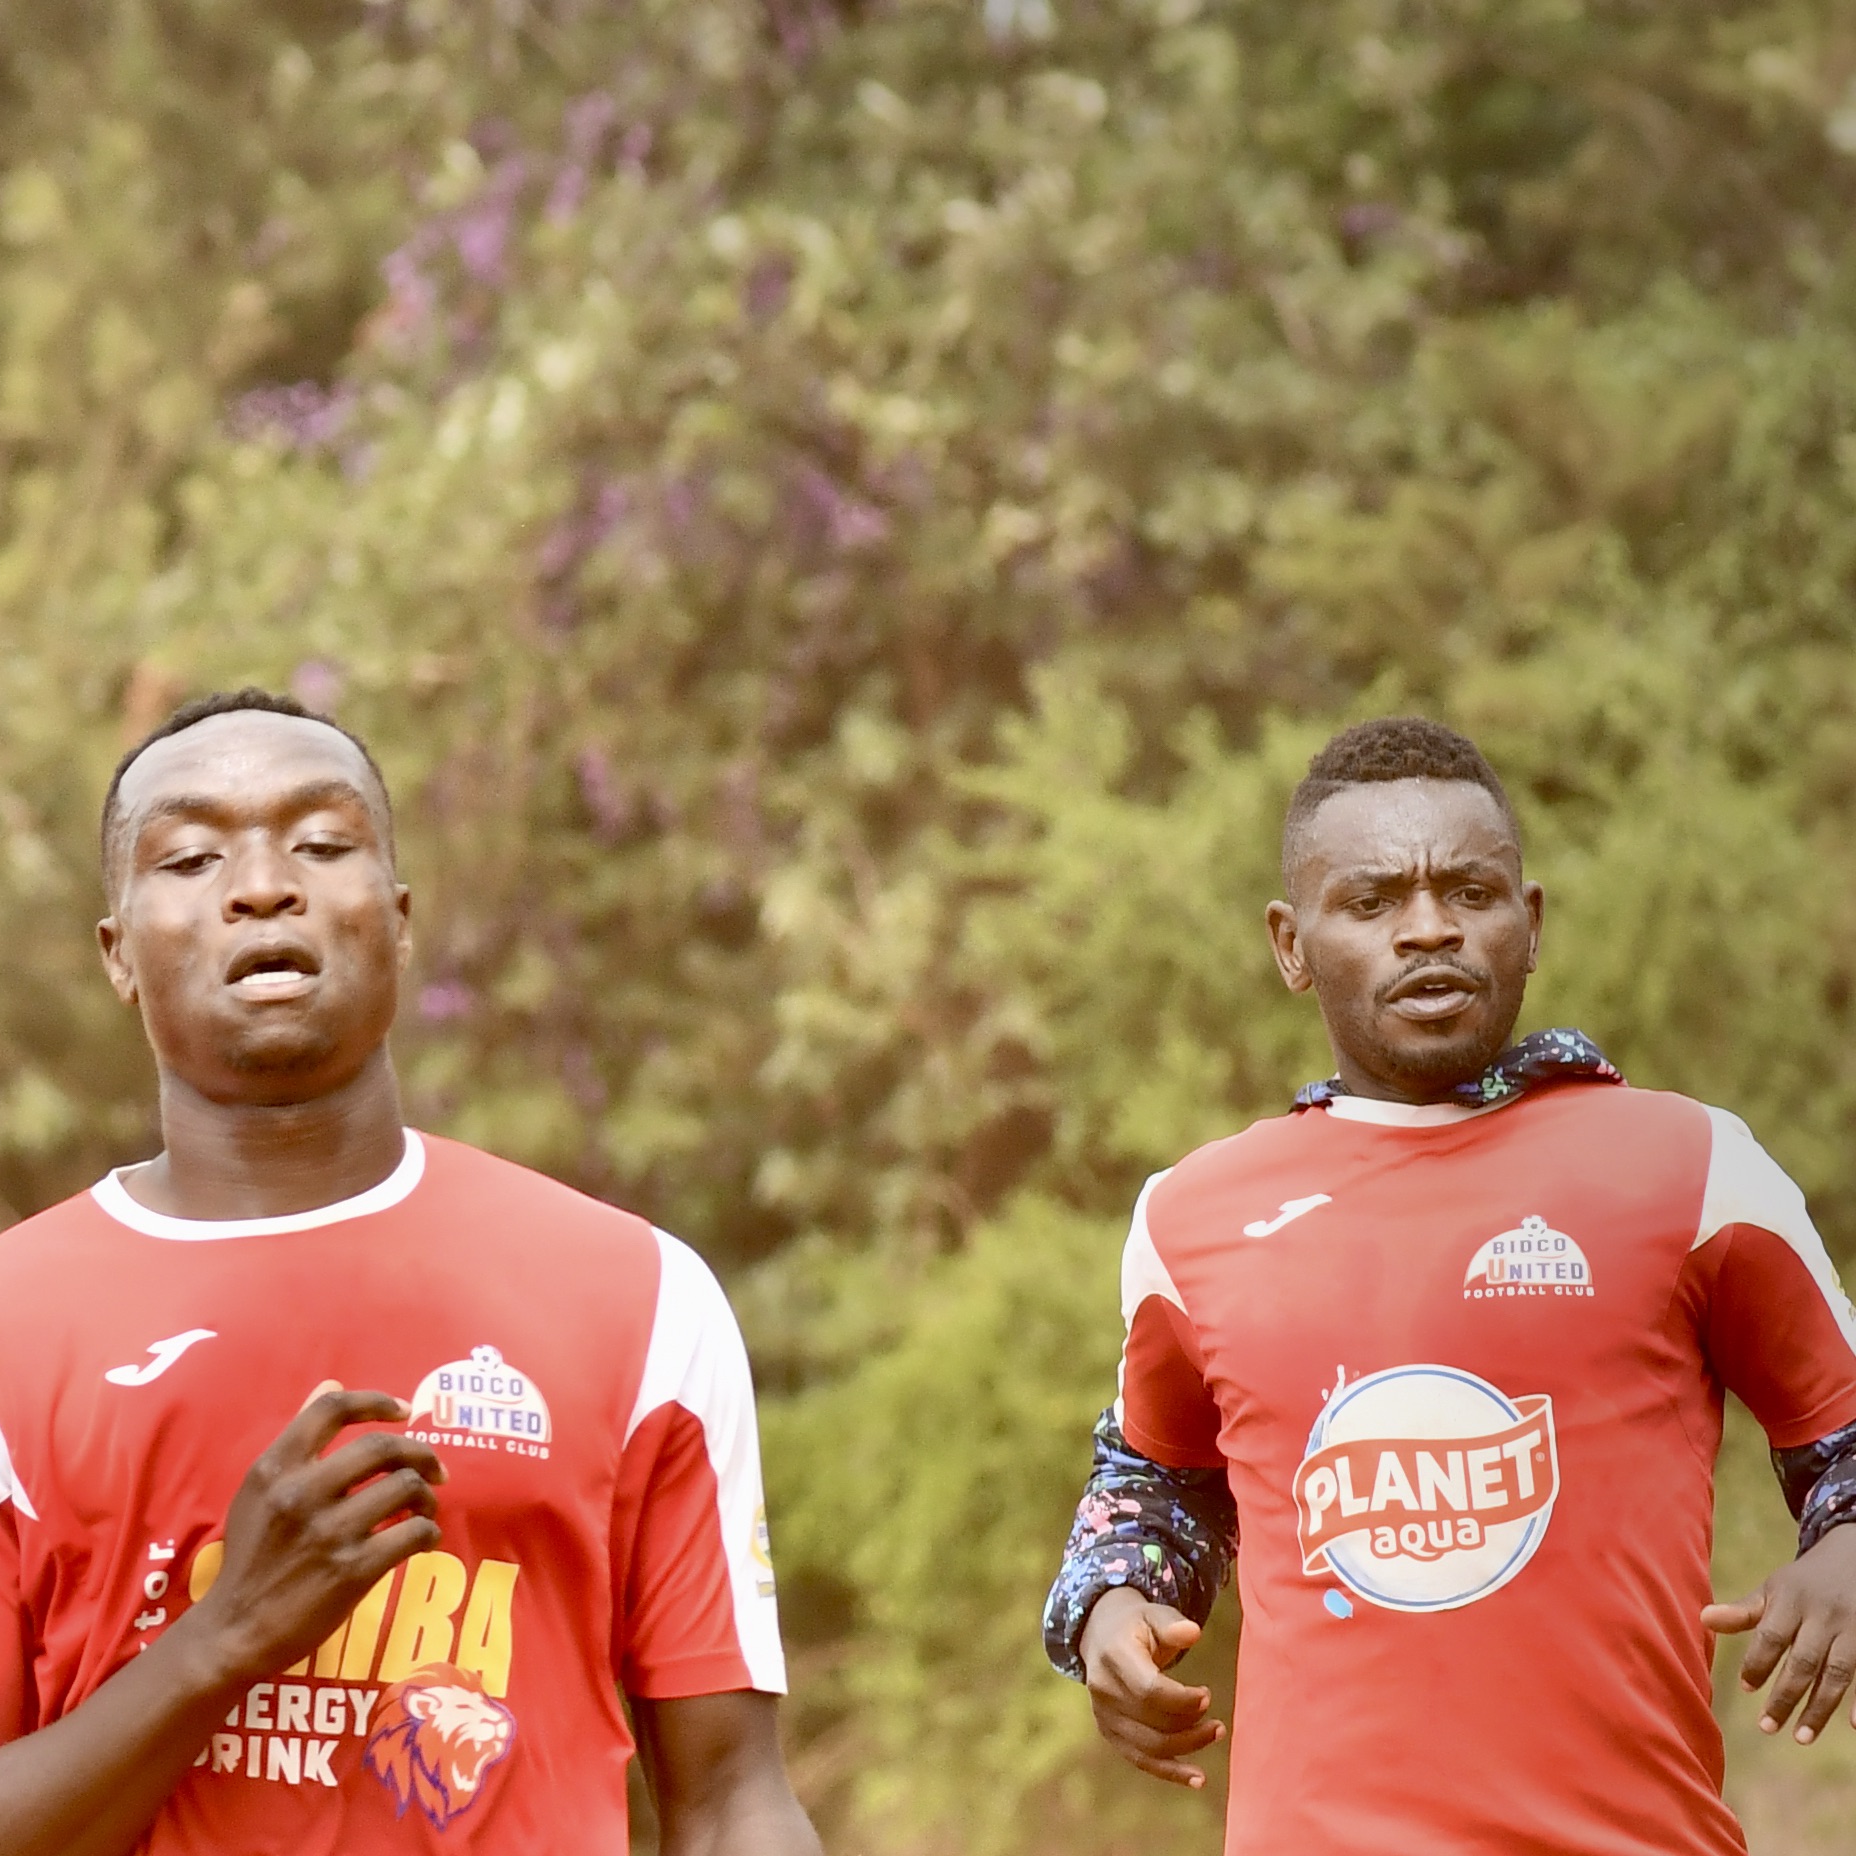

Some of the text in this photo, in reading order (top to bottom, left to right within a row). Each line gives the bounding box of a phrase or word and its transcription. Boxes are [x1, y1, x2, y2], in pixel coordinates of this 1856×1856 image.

[1493, 1238, 1566, 1255] BIDCO
[1488, 1258, 1584, 1281] UNITED
[1463, 1285, 1595, 1300] FOOTBALL CLUB
[439, 1373, 523, 1396] BIDCO
[434, 1394, 541, 1434] UNITED
[505, 1440, 550, 1459] CLUB
[1304, 1428, 1542, 1536] PLANET
[1374, 1517, 1480, 1557] aqua
[225, 1682, 379, 1736] ERGY
